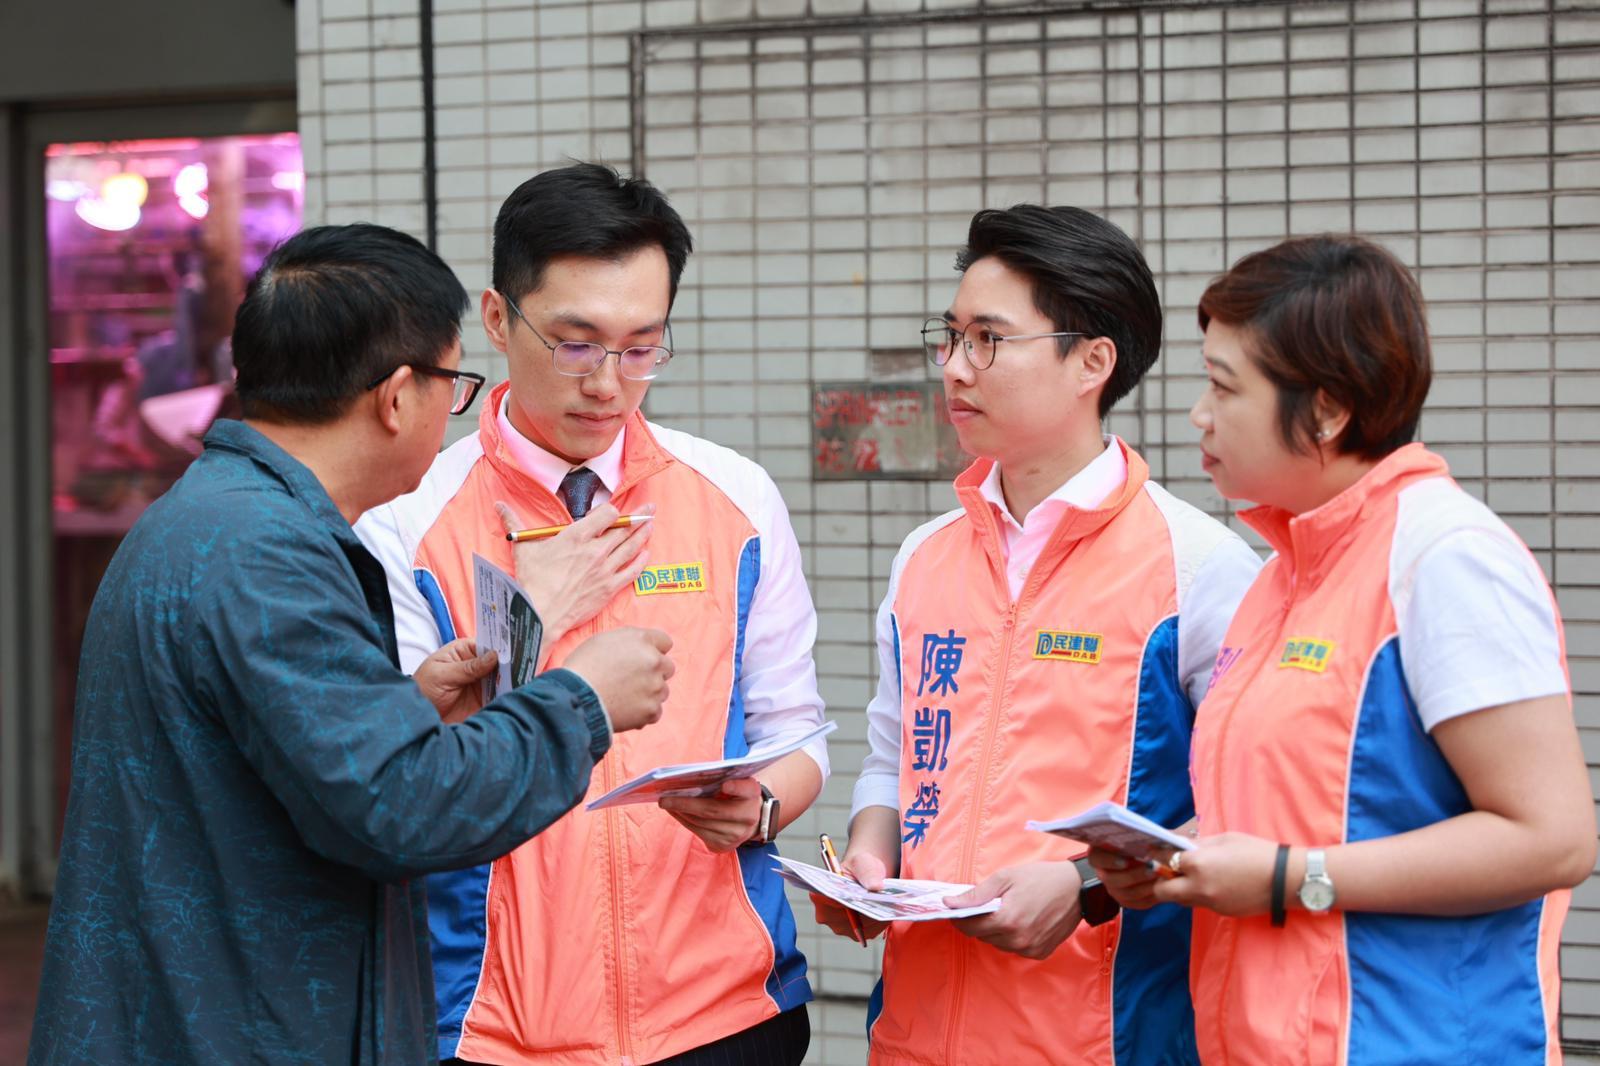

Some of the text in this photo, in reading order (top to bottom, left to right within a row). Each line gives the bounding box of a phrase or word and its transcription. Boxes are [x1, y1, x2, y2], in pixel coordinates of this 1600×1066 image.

[679, 581, 702, 589] DAB
[1054, 634, 1099, 652] 民建聯
[1073, 651, 1097, 659] DAB
[902, 629, 967, 849] 陳凱榮
